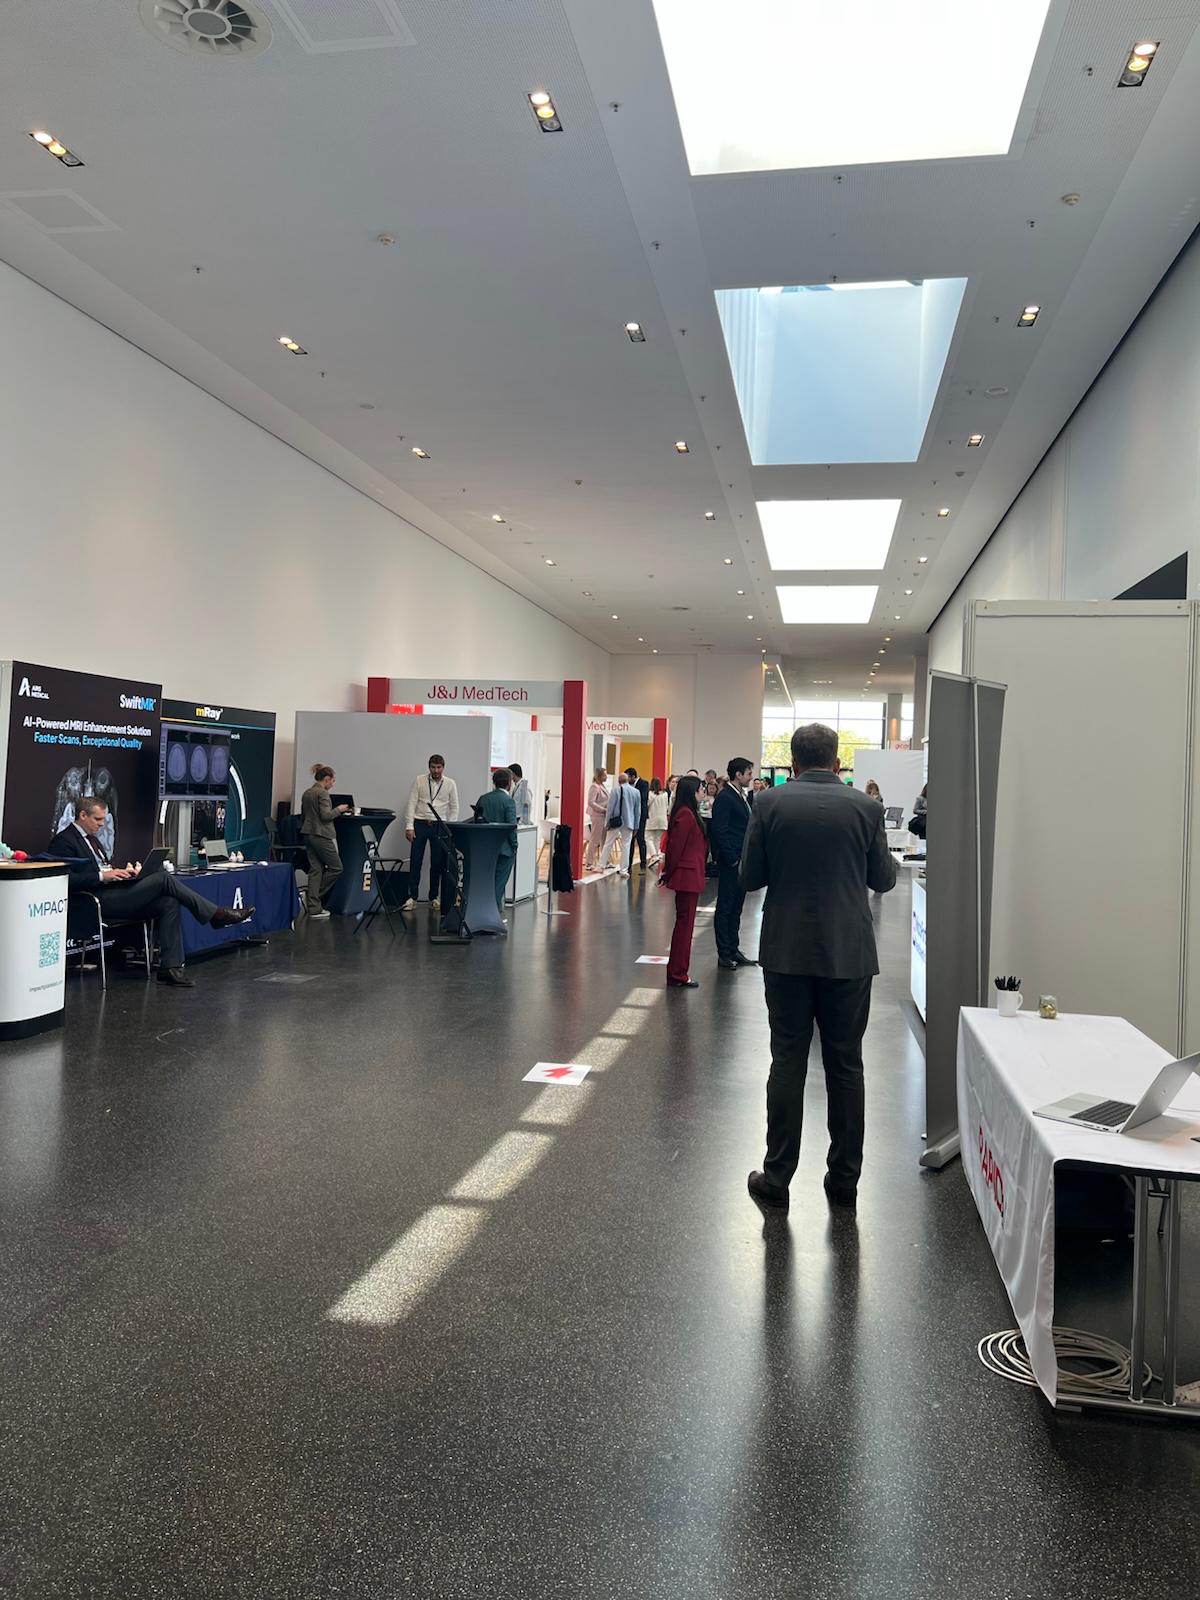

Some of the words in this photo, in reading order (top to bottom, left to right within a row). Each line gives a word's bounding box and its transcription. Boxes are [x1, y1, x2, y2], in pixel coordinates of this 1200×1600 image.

[427, 685, 458, 699] J&J
[462, 686, 528, 701] MedTech
[23, 715, 70, 730] AI-Powered
[70, 720, 83, 731] MRI
[83, 721, 126, 735] Enhancement
[127, 725, 152, 736] Solution
[34, 732, 58, 743] Faster
[58, 734, 82, 746] Scans,
[82, 735, 121, 748] Exceptional
[121, 738, 142, 750] Quality
